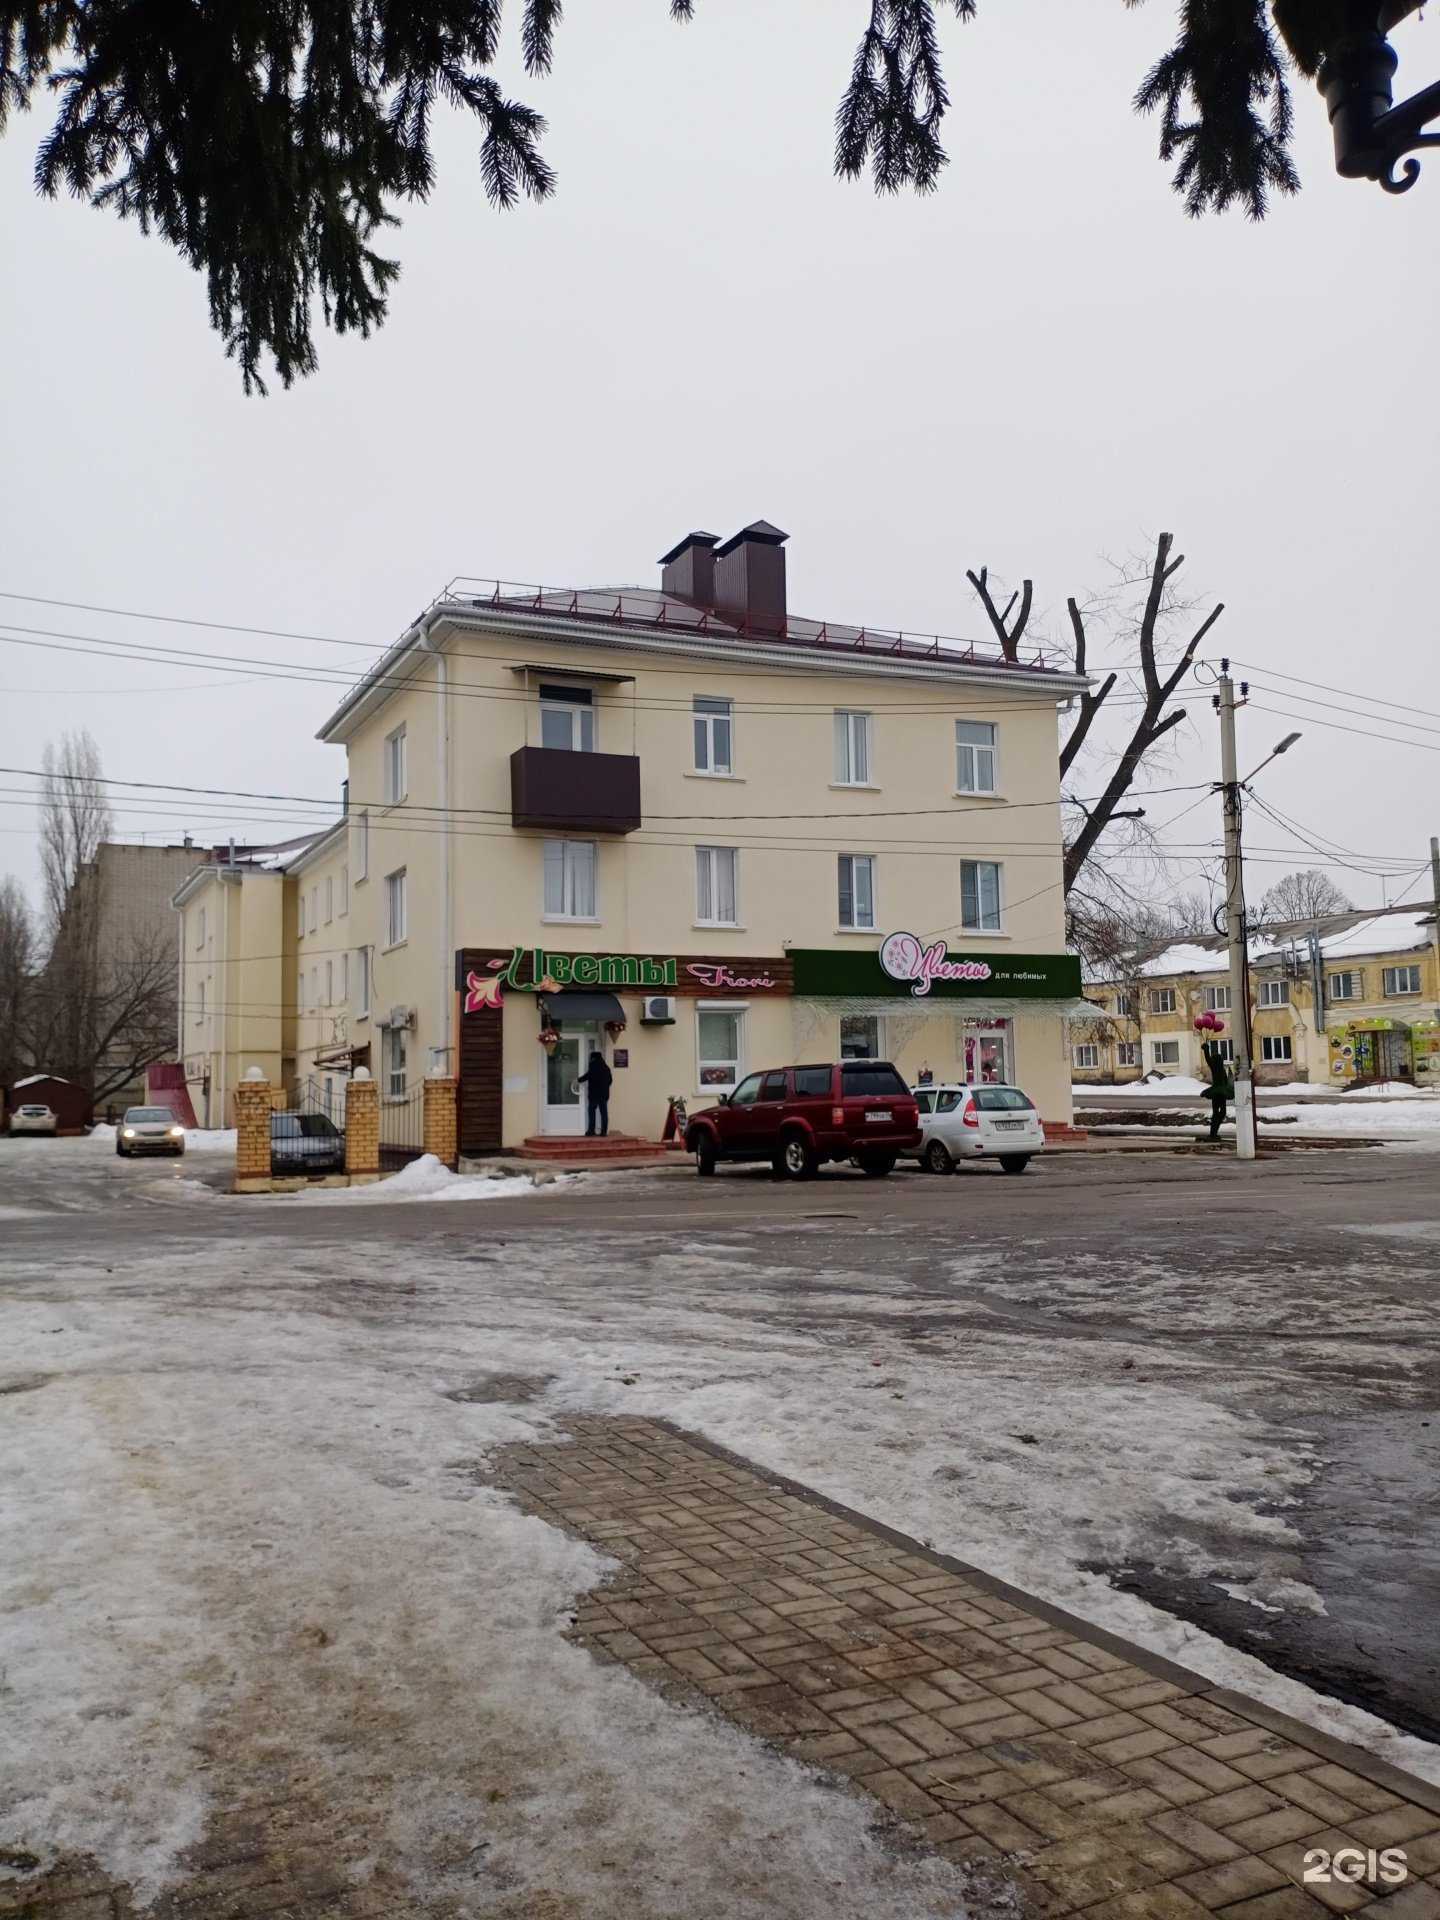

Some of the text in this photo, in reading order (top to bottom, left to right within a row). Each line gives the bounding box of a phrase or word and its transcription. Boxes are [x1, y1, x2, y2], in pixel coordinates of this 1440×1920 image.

[505, 947, 678, 992] Цветы
[686, 963, 775, 987] Fiori
[899, 935, 991, 996] Цветы
[995, 971, 1047, 981] для любимых
